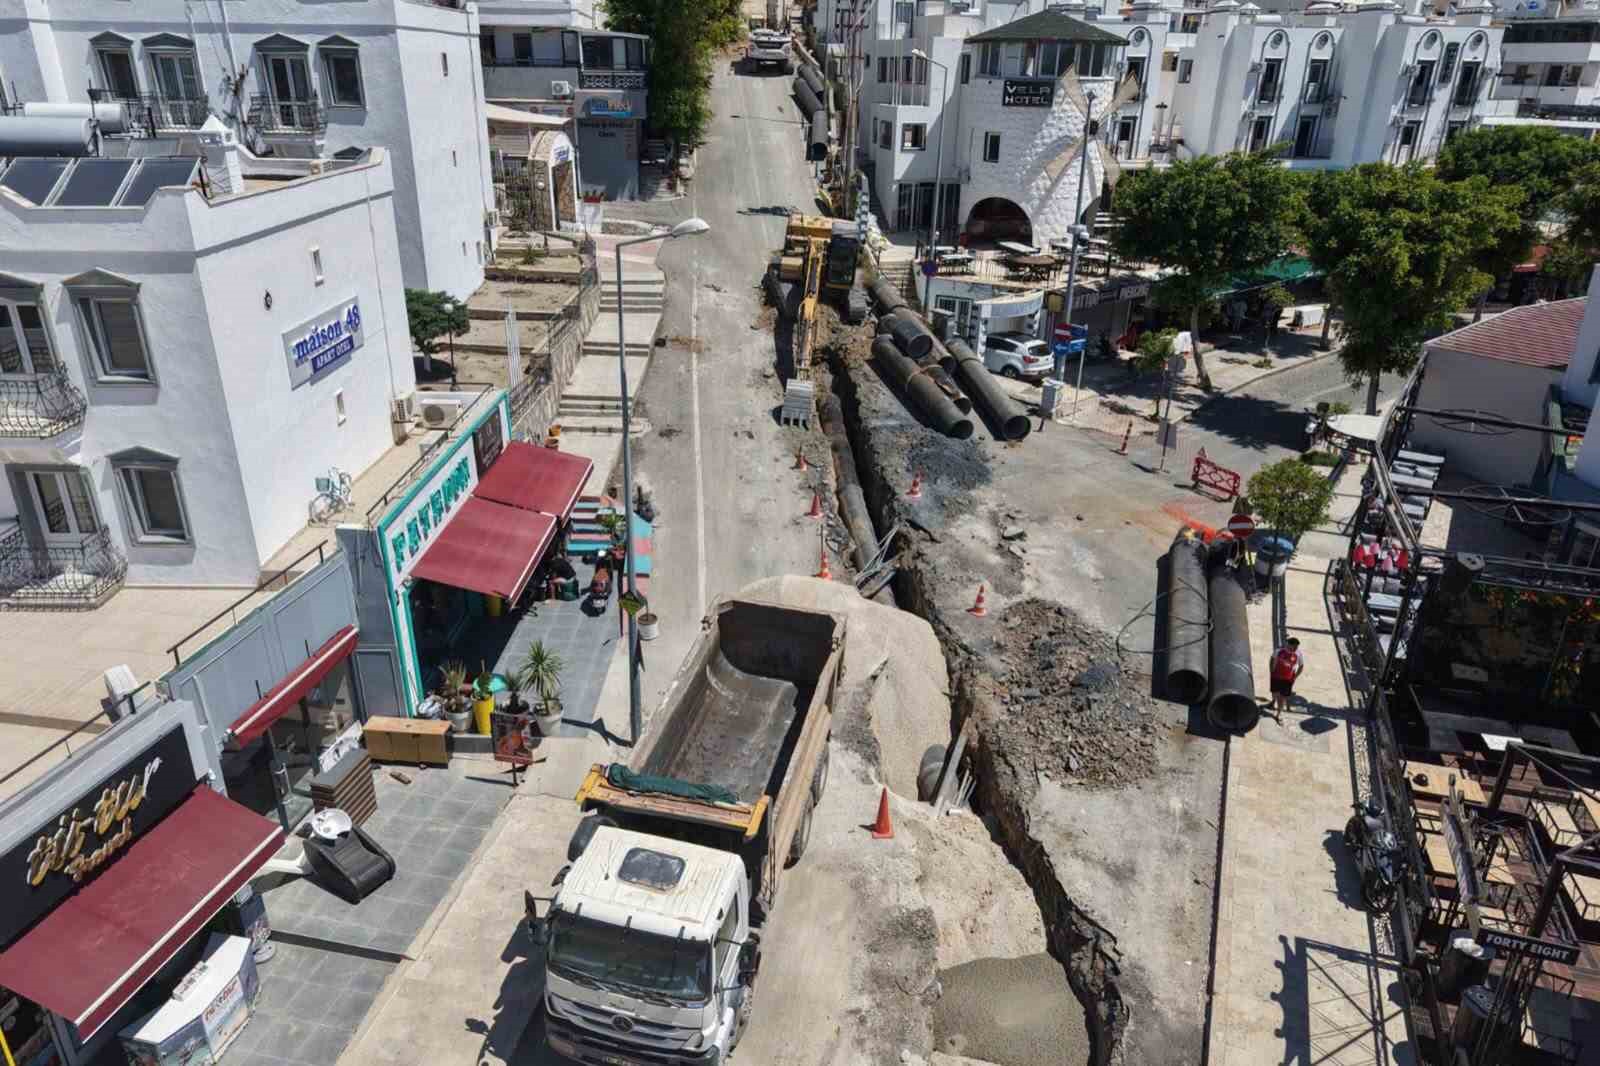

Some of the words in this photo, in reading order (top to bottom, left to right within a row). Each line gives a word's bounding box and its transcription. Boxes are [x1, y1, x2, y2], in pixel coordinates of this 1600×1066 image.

[1005, 96, 1049, 105] HOTEL
[294, 320, 343, 362] maison
[345, 304, 361, 333] 48
[1486, 934, 1528, 950] FORTY
[1530, 944, 1569, 960] EIGHT
